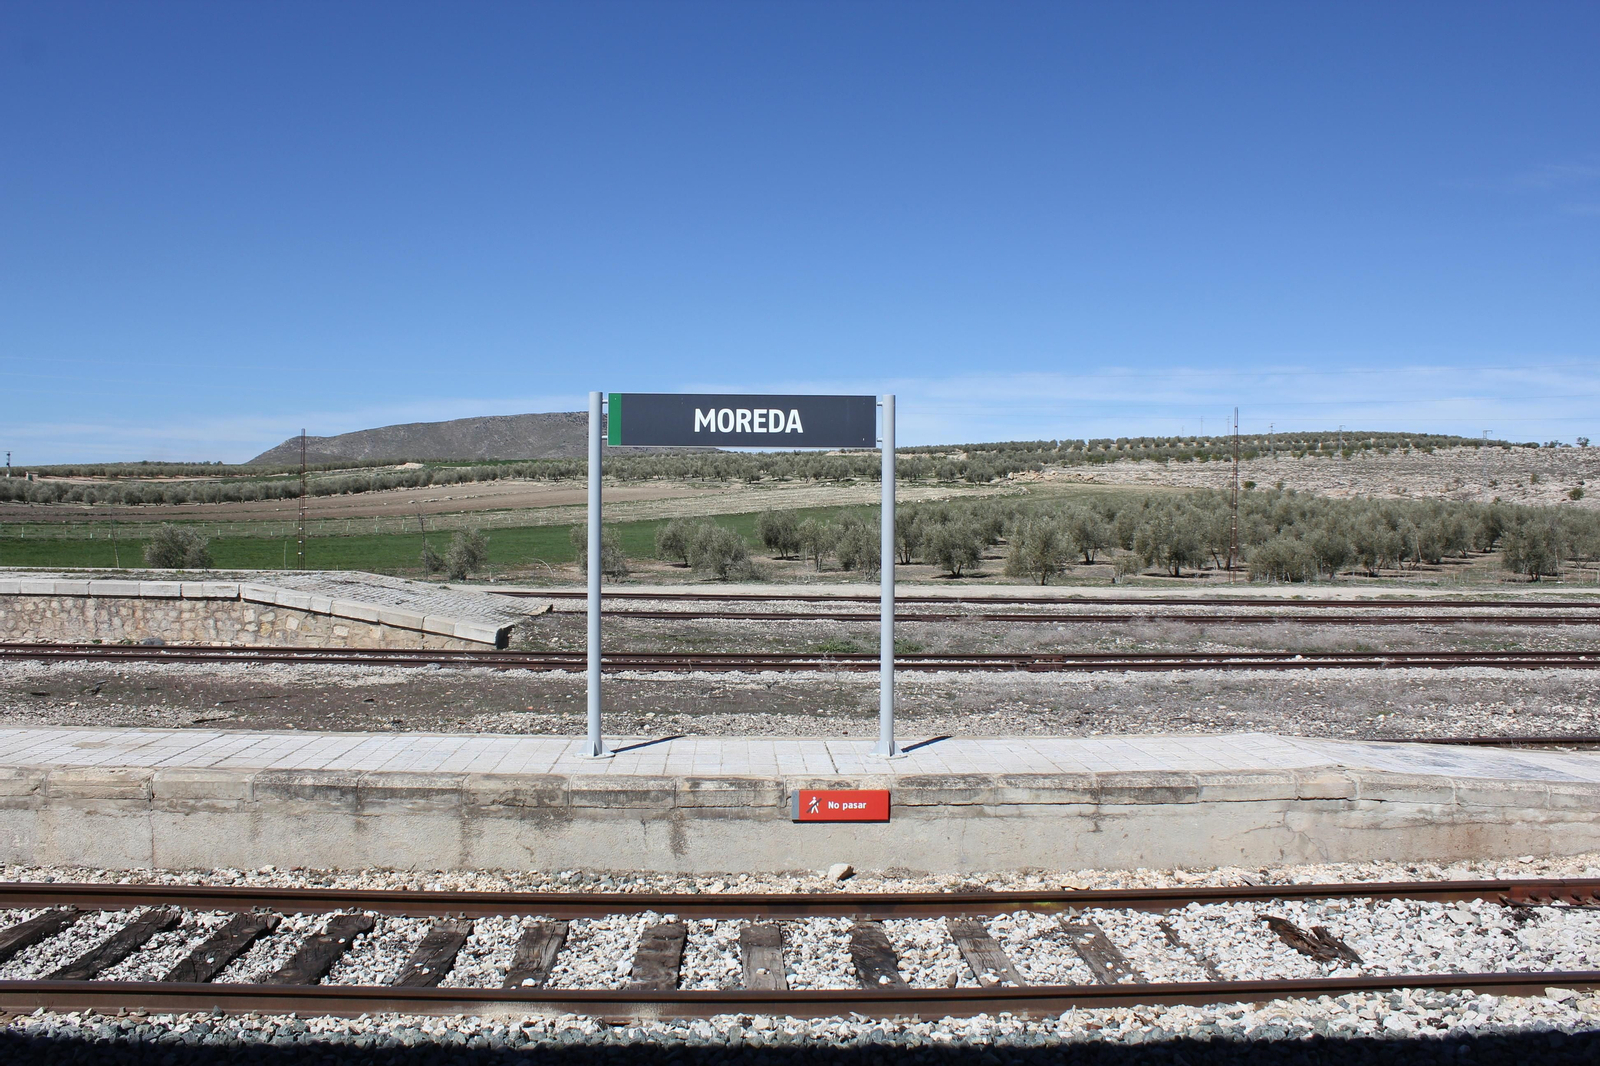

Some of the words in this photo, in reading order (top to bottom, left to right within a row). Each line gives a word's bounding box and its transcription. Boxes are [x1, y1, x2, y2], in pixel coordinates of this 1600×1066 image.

[694, 408, 804, 433] MOREDA
[828, 801, 840, 809] No
[842, 802, 867, 811] pasar
